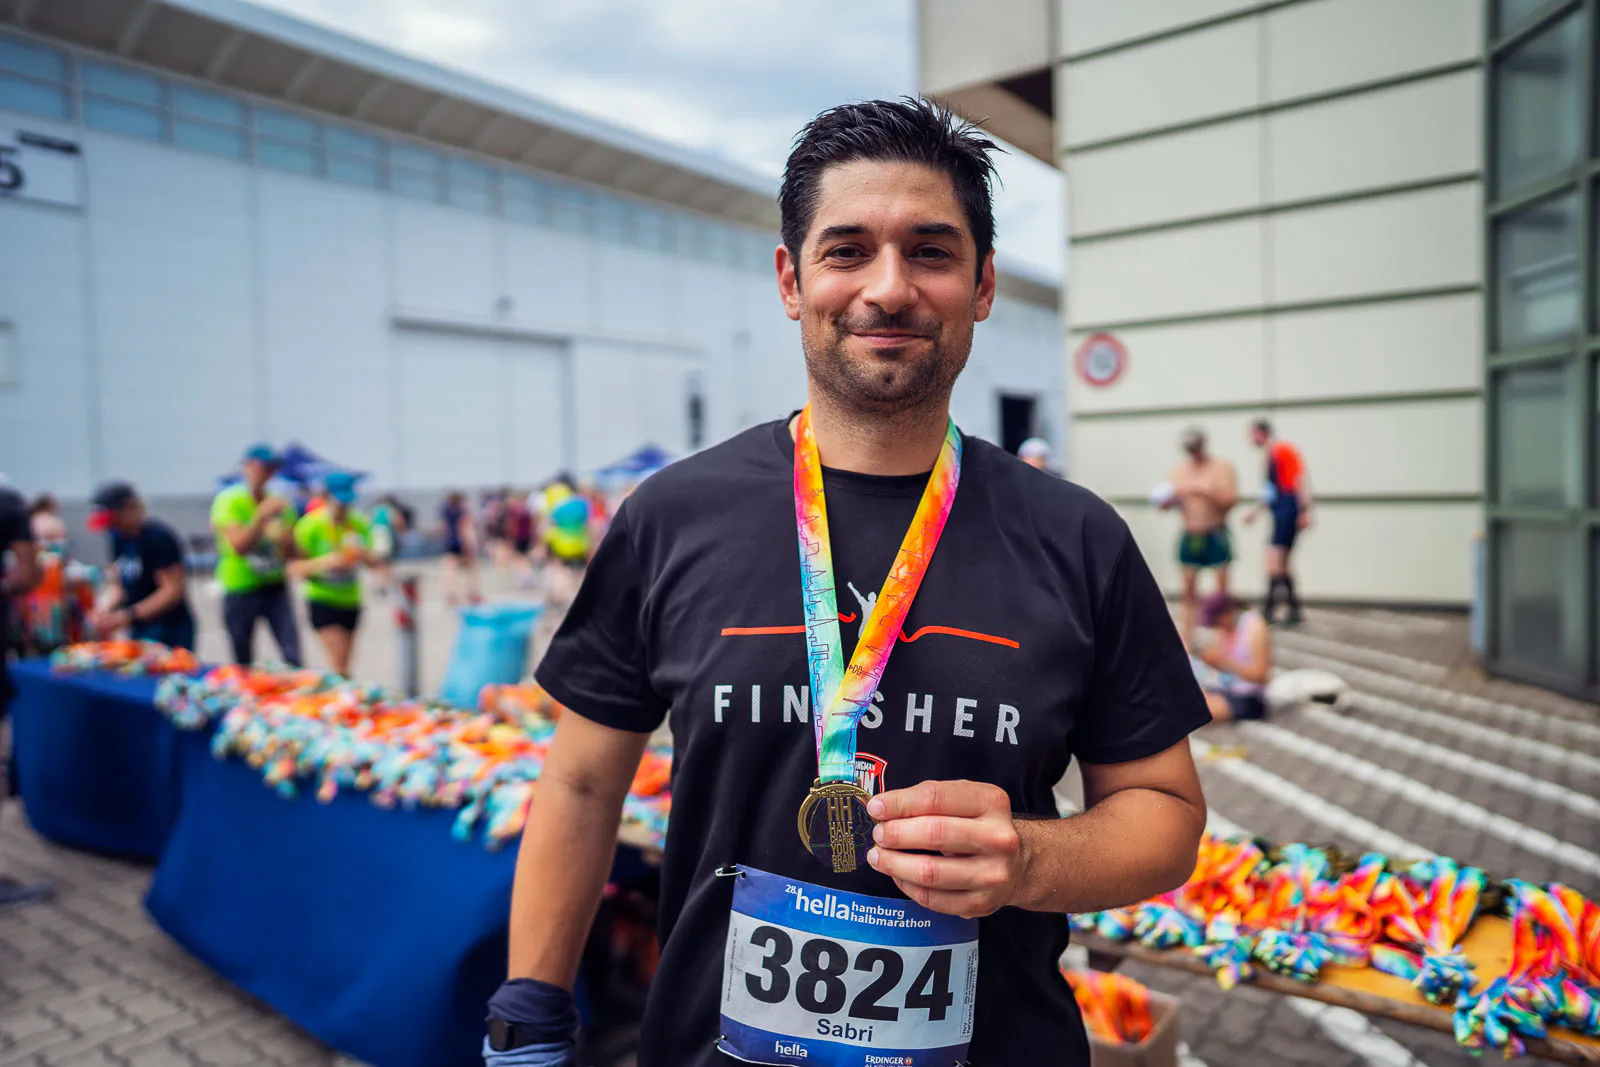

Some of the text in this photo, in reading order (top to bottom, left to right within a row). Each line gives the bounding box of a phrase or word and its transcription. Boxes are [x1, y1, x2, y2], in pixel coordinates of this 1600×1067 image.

[714, 685, 1021, 745] FINSHER
[827, 797, 853, 821] HH
[828, 821, 853, 835] HALF
[830, 834, 855, 844] CHARGE
[830, 843, 856, 855] YOUR
[832, 854, 857, 865] BRAIN
[796, 888, 851, 921] hella
[852, 901, 905, 919] hamburg
[850, 913, 931, 928] halbmarathon
[745, 925, 954, 1022] 3824
[816, 1018, 873, 1043] Sabri
[774, 1040, 808, 1058] hella
[865, 1054, 904, 1065] ERDINGER
